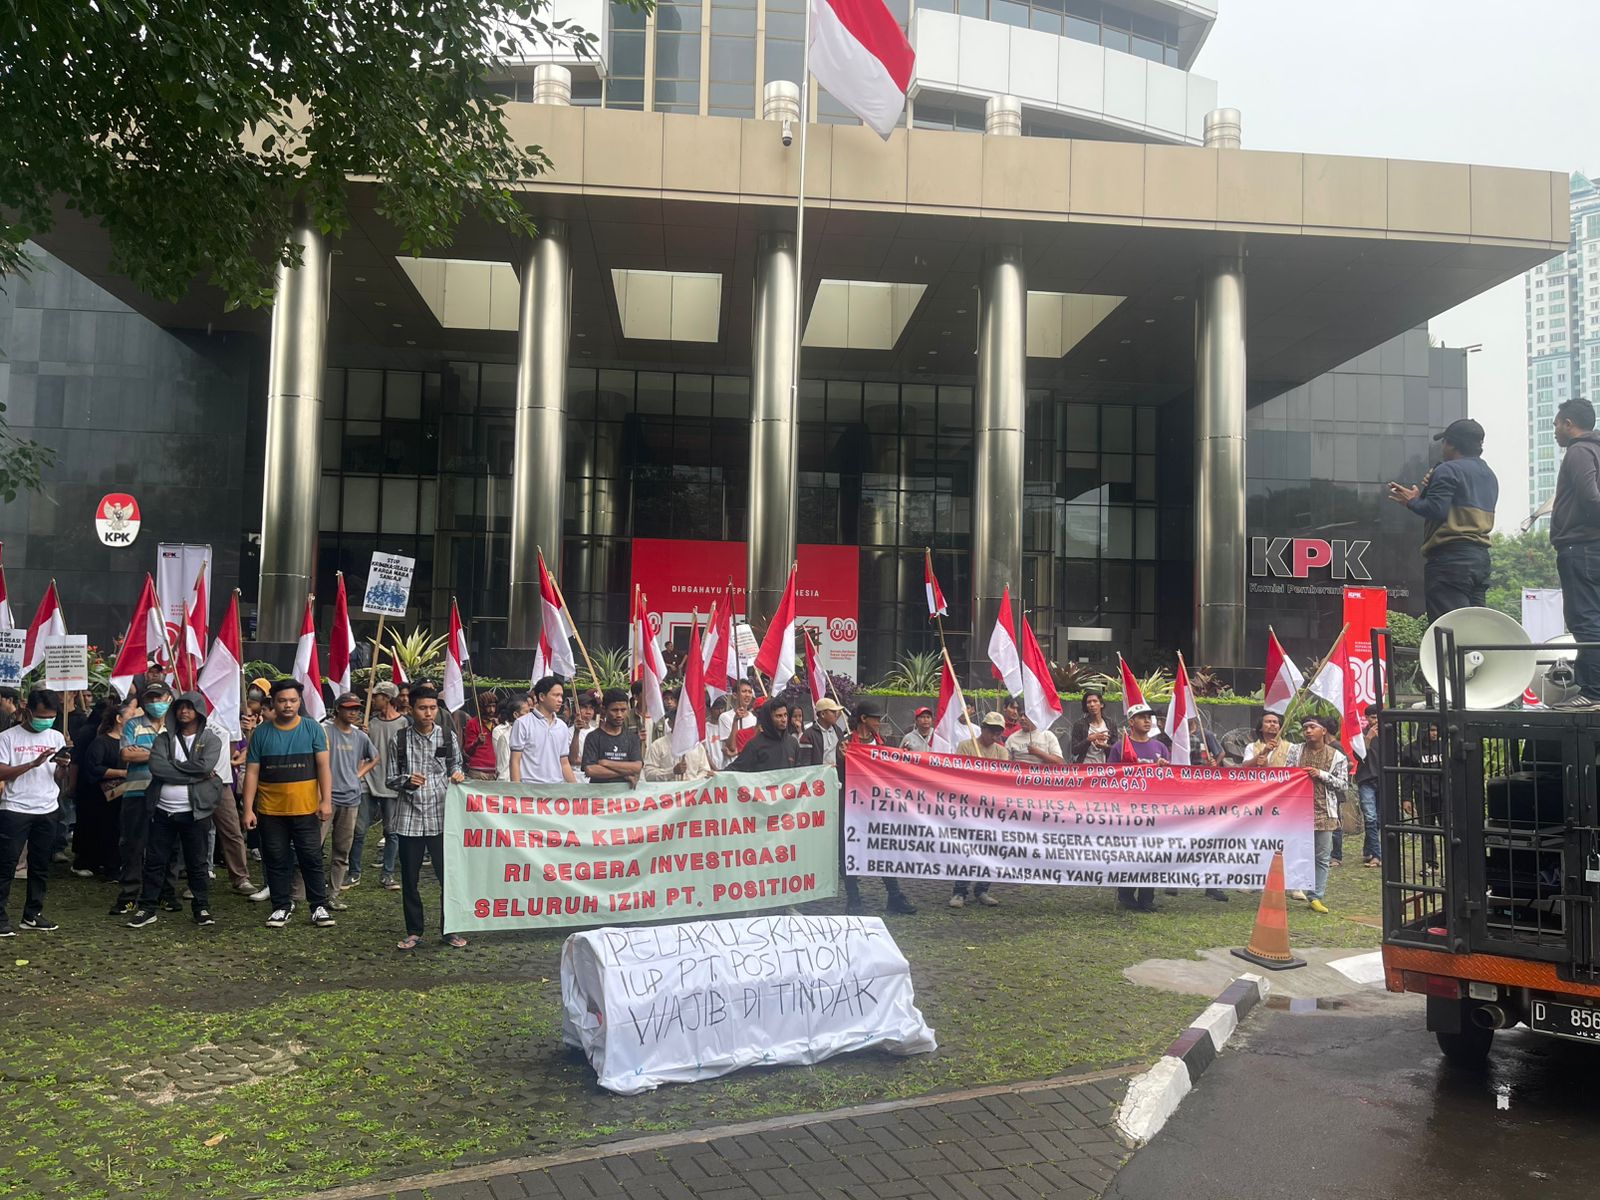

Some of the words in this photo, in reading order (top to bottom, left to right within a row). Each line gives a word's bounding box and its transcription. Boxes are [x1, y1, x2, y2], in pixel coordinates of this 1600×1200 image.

[105, 532, 130, 542] KPK
[1252, 537, 1372, 580] KPK
[671, 585, 722, 594] DIRGAHAYU
[1249, 583, 1285, 594] Komisi
[1287, 584, 1344, 595] Pemberant
[830, 617, 857, 642] 80
[871, 750, 921, 764] FRONT
[929, 757, 1022, 773] MAHASISWA
[1030, 765, 1079, 776] MALUT
[1087, 766, 1116, 777] PRO
[1124, 767, 1174, 780] WARGA
[1181, 769, 1222, 780] MABA
[1229, 770, 1290, 783] SANGAJI
[466, 787, 728, 815] MEREKOMENDASIKAN
[737, 780, 826, 803] SATGAS
[1016, 776, 1084, 788] (FORMAT
[1091, 778, 1147, 791] PRAGA)
[850, 789, 864, 805] 1.
[872, 786, 926, 802] DESAK
[937, 792, 969, 804] KPK
[980, 796, 995, 807] RI
[1006, 797, 1076, 811] PERIKSA
[1086, 802, 1120, 813] IZIN
[1130, 803, 1263, 818] PERTAMBANGAN
[1272, 807, 1280, 816] &
[871, 800, 908, 813] IZIN
[917, 803, 1032, 822] LINGKUNGAN
[1042, 811, 1065, 823] PT.
[1075, 813, 1156, 827] POSITION
[463, 828, 581, 848] MINERBA
[592, 816, 756, 847] KEMENTERIAN
[767, 810, 826, 832] ESDM
[847, 826, 861, 842] 2.
[868, 822, 934, 838] MEMINTA
[939, 827, 997, 842] MENTERI
[1002, 831, 1038, 844] ESDM
[1042, 833, 1094, 847] SEGERA
[1096, 836, 1137, 848] CABUT
[1142, 837, 1164, 849] IUP
[1168, 837, 1186, 849] PT.
[1190, 838, 1247, 850] POSITION
[1251, 839, 1284, 852] YANG
[504, 863, 531, 882] RI
[543, 859, 641, 881] SEGERA
[650, 845, 796, 874] INVESTIGASI
[867, 837, 935, 851] MERUSAK
[940, 841, 1027, 859] LINGKUNGAN
[1032, 848, 1041, 859] &
[1045, 848, 1172, 864] MENYENGSARAKAN
[1176, 852, 1260, 864] MASYARAKAT
[846, 855, 860, 871] 3.
[867, 860, 941, 875] BERANTAS
[946, 864, 991, 878] MAFIA
[995, 866, 1061, 881] TAMBANG
[1066, 870, 1103, 883] YANG
[1107, 871, 1200, 887] MEMMBEKING
[1205, 873, 1222, 885] PT.
[1227, 874, 1266, 886] POSITI
[474, 896, 598, 918] SELURUH
[609, 890, 656, 912] IZIN
[666, 886, 703, 907] PT.
[713, 873, 815, 901] POSITION
[605, 921, 740, 966] PELAKU
[747, 916, 879, 951] SKANDAL
[620, 969, 663, 998] IUP
[731, 944, 850, 979] POSITION
[628, 990, 727, 1046] WAJIB
[744, 987, 760, 1018] DI
[770, 973, 878, 1016] TINDAK
[1536, 1003, 1545, 1020] D
